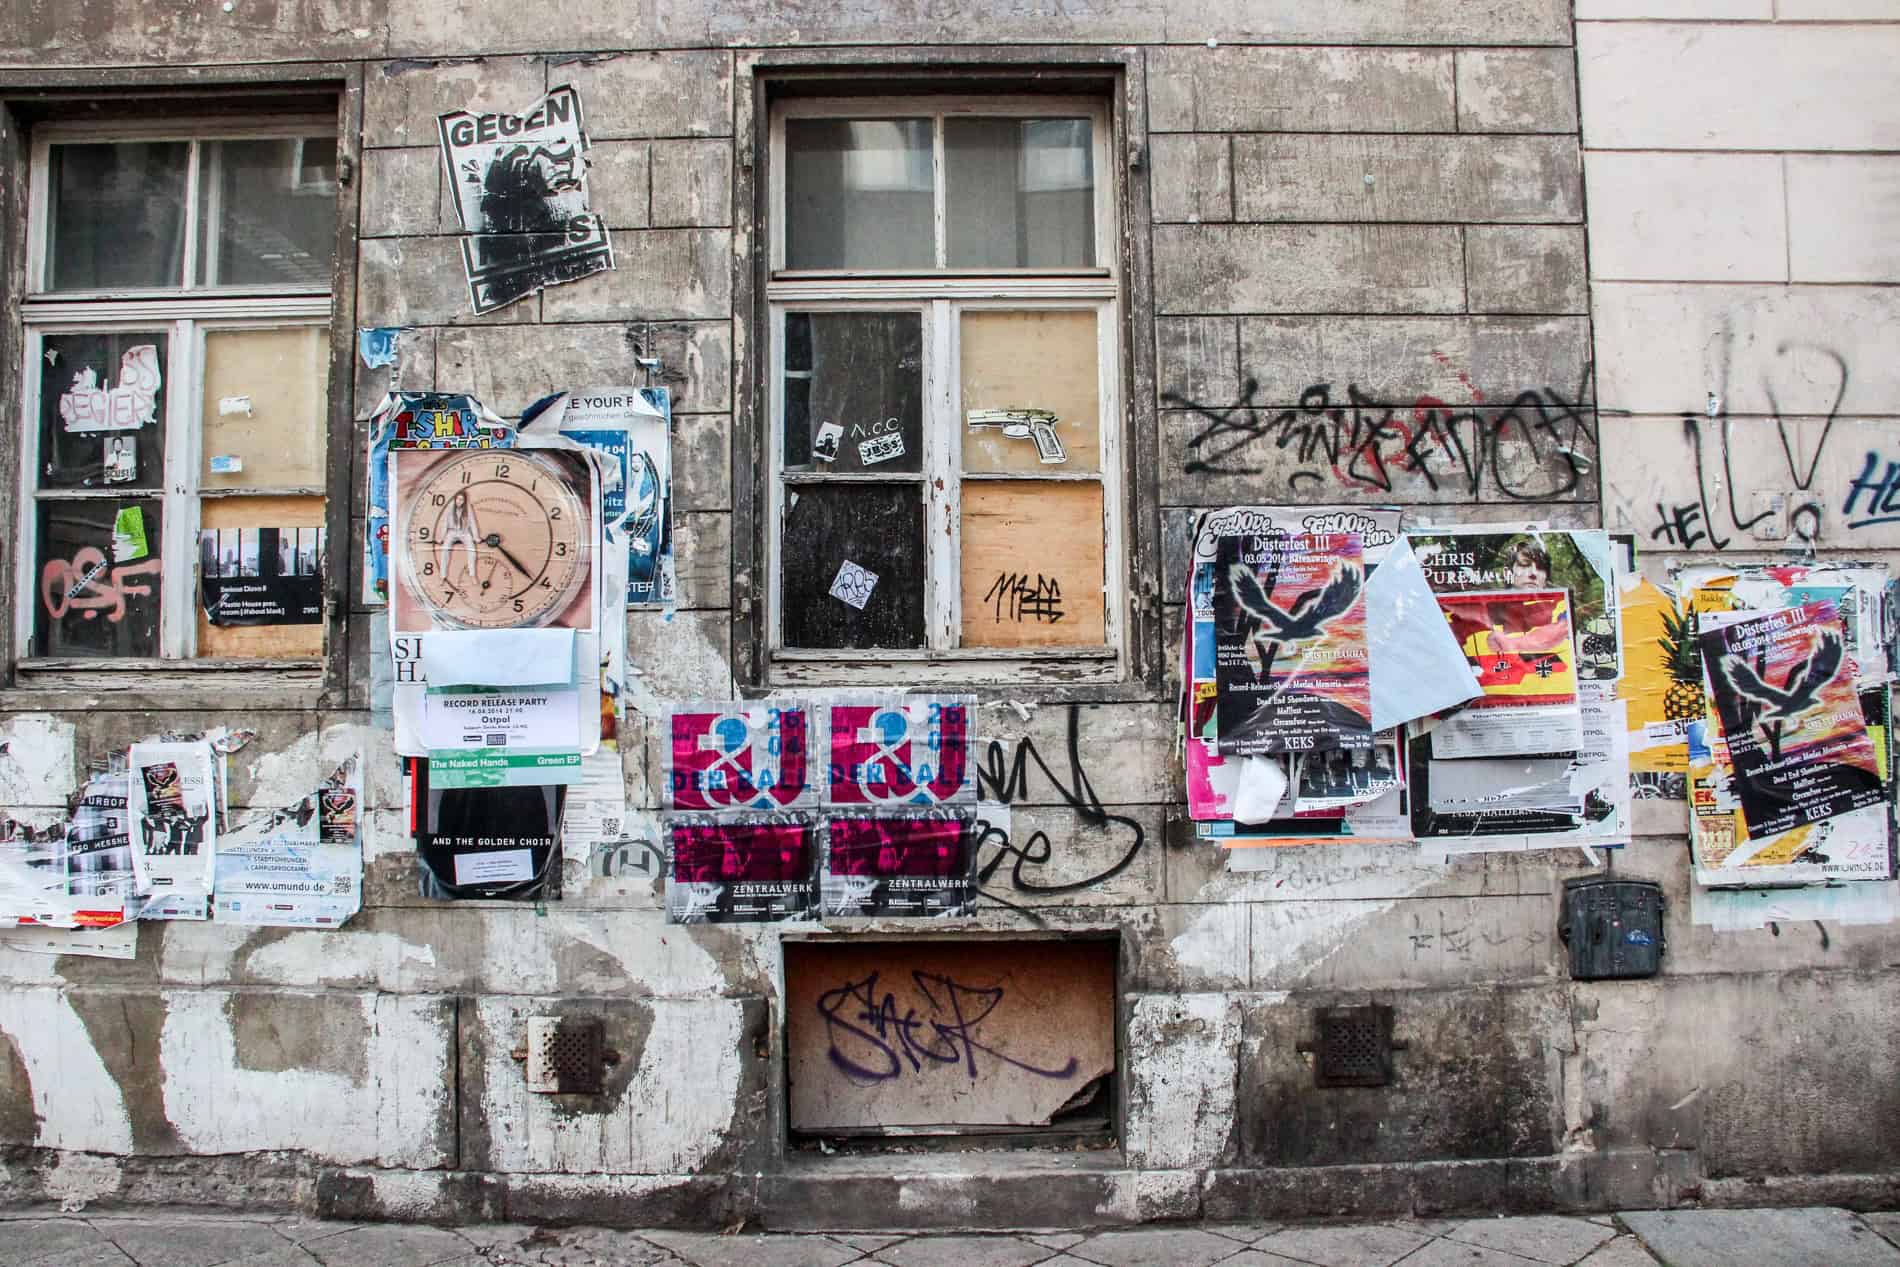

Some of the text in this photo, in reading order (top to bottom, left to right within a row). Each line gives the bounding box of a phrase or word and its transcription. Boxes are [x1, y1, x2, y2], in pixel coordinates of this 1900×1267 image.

[584, 396, 622, 409] YOUR
[461, 471, 471, 484] 11
[495, 465, 509, 478] 12
[431, 494, 445, 507] 10
[551, 507, 561, 520] 2
[419, 527, 429, 540] 9
[1254, 535, 1331, 551] Düsterfest III
[555, 543, 566, 557] 3
[423, 562, 434, 575] 8
[513, 600, 523, 613] 5
[1735, 607, 1806, 640] Düsterfest III
[444, 697, 547, 708] RECORD RELEASE PARTY
[481, 715, 510, 725] Ostpol
[1284, 736, 1314, 750] KEKS
[432, 755, 579, 768] The Naked Hands Green EP
[669, 770, 728, 791] DER
[827, 763, 886, 785] DER
[1805, 803, 1833, 821] KEKS
[432, 837, 551, 846] AND THE GOLDEN CHOIR
[733, 883, 813, 894] ZENTRALWERK
[888, 879, 969, 889] ZENTRALWERK
